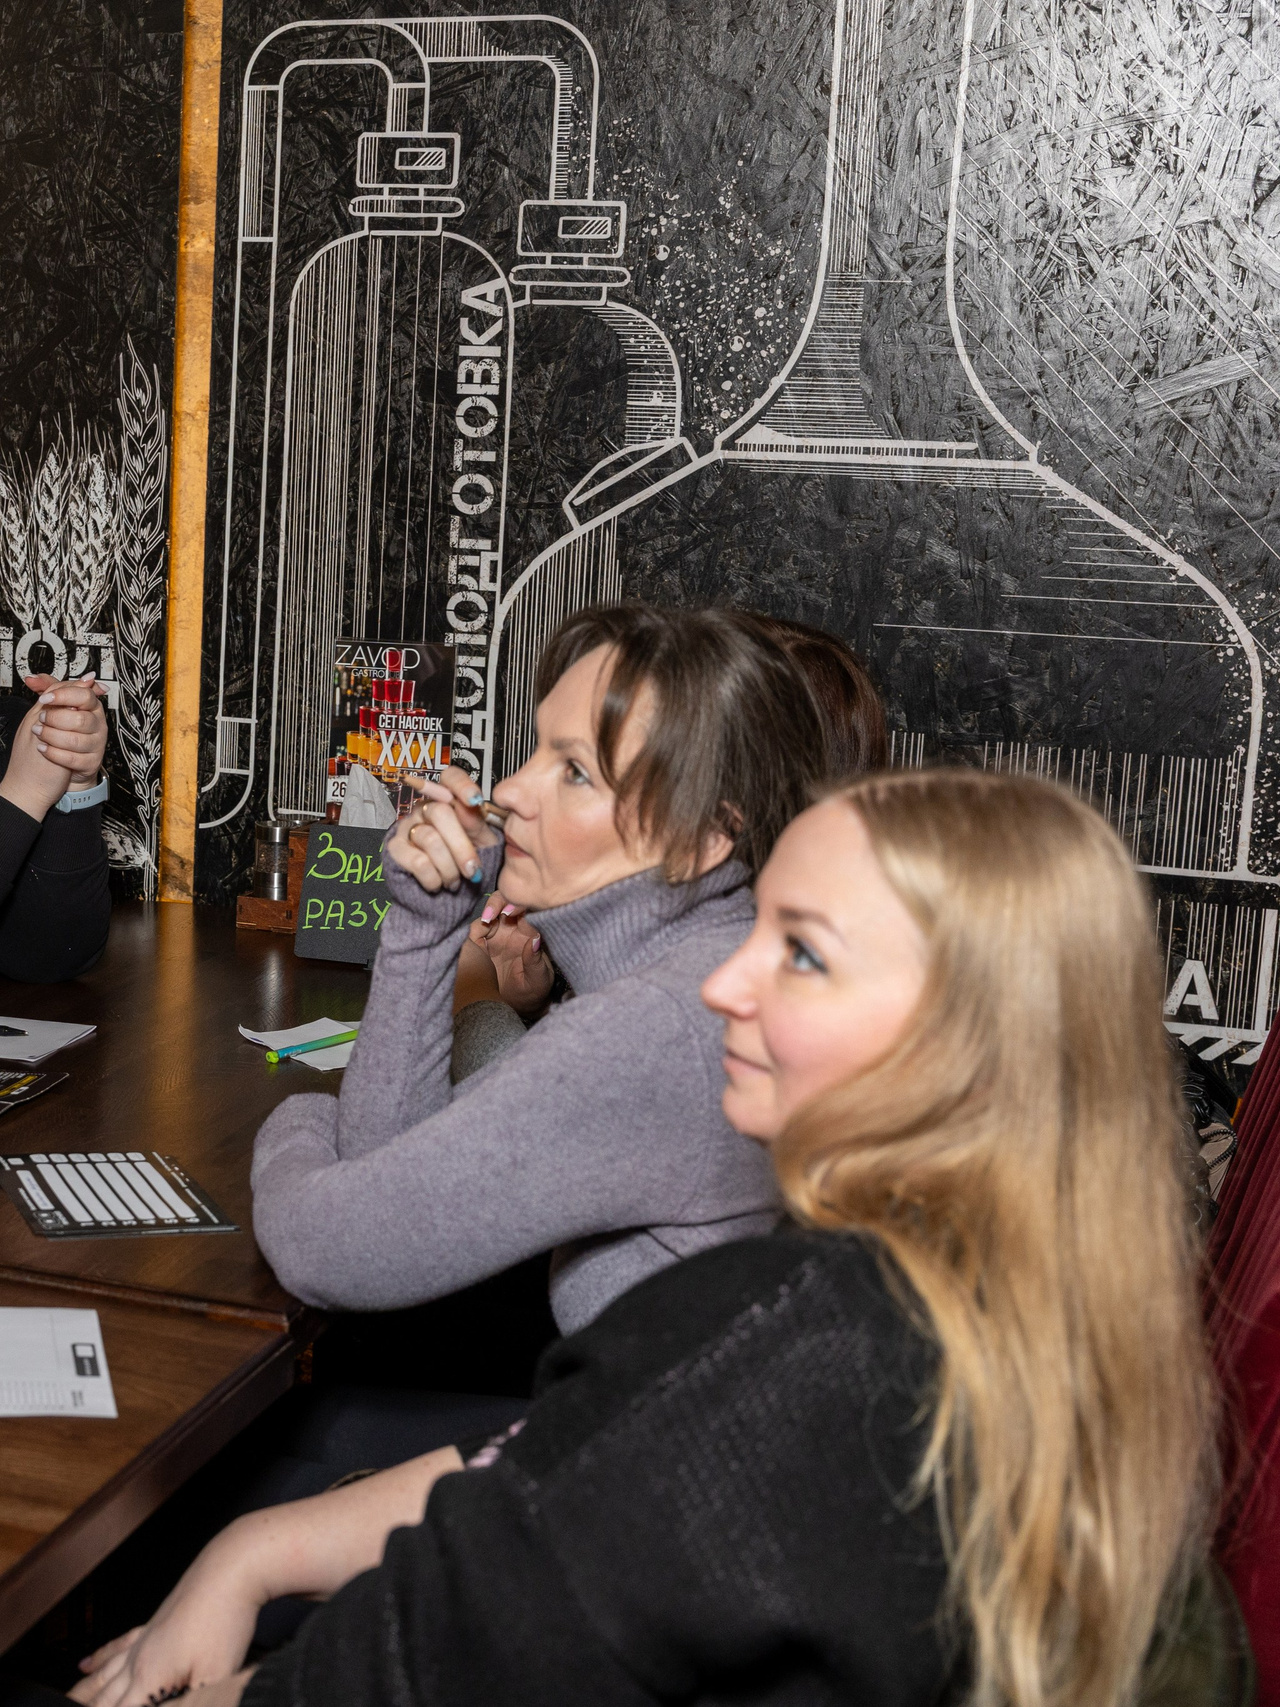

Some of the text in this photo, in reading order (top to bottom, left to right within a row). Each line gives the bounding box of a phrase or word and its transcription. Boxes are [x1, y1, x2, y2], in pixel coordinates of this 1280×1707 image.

[335, 644, 421, 669] ZAVOD
[378, 714, 443, 732] СЕТ НАСТОЕК
[377, 730, 449, 770] XXXL
[302, 898, 392, 931] РАЗУ
